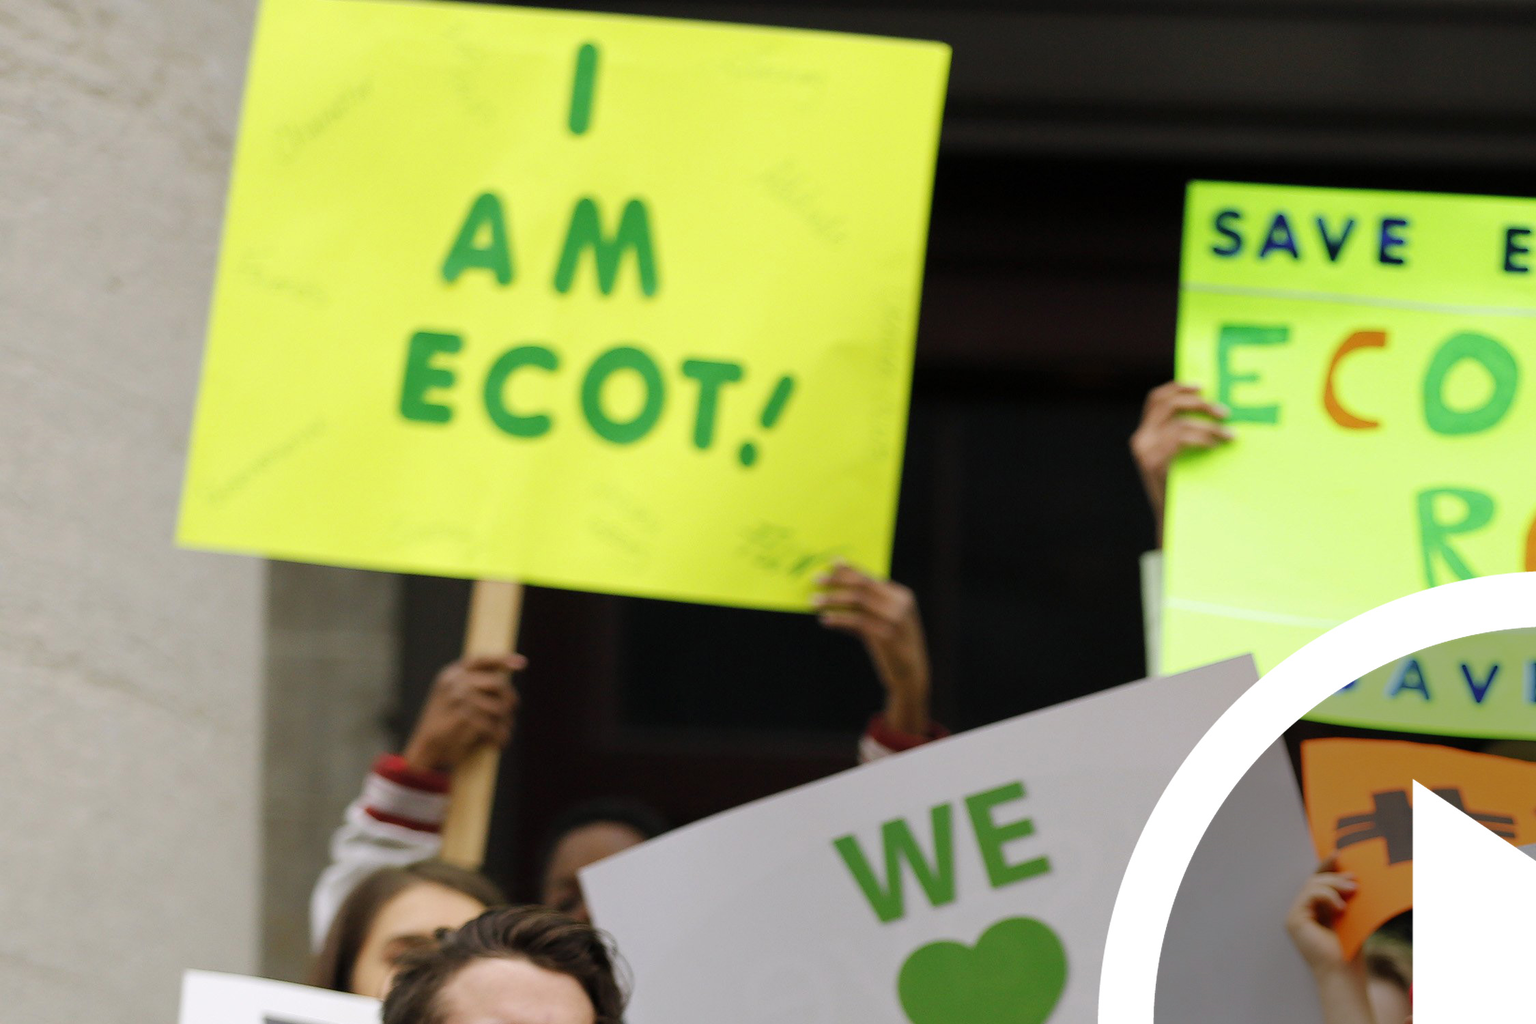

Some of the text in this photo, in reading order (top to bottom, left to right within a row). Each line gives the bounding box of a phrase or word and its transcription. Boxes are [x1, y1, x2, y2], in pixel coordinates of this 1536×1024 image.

[565, 41, 599, 137] I
[440, 191, 516, 288] A
[553, 195, 661, 299] M
[1210, 209, 1413, 266] SAVE
[396, 329, 797, 469] ECOT!
[831, 780, 1053, 926] WE
